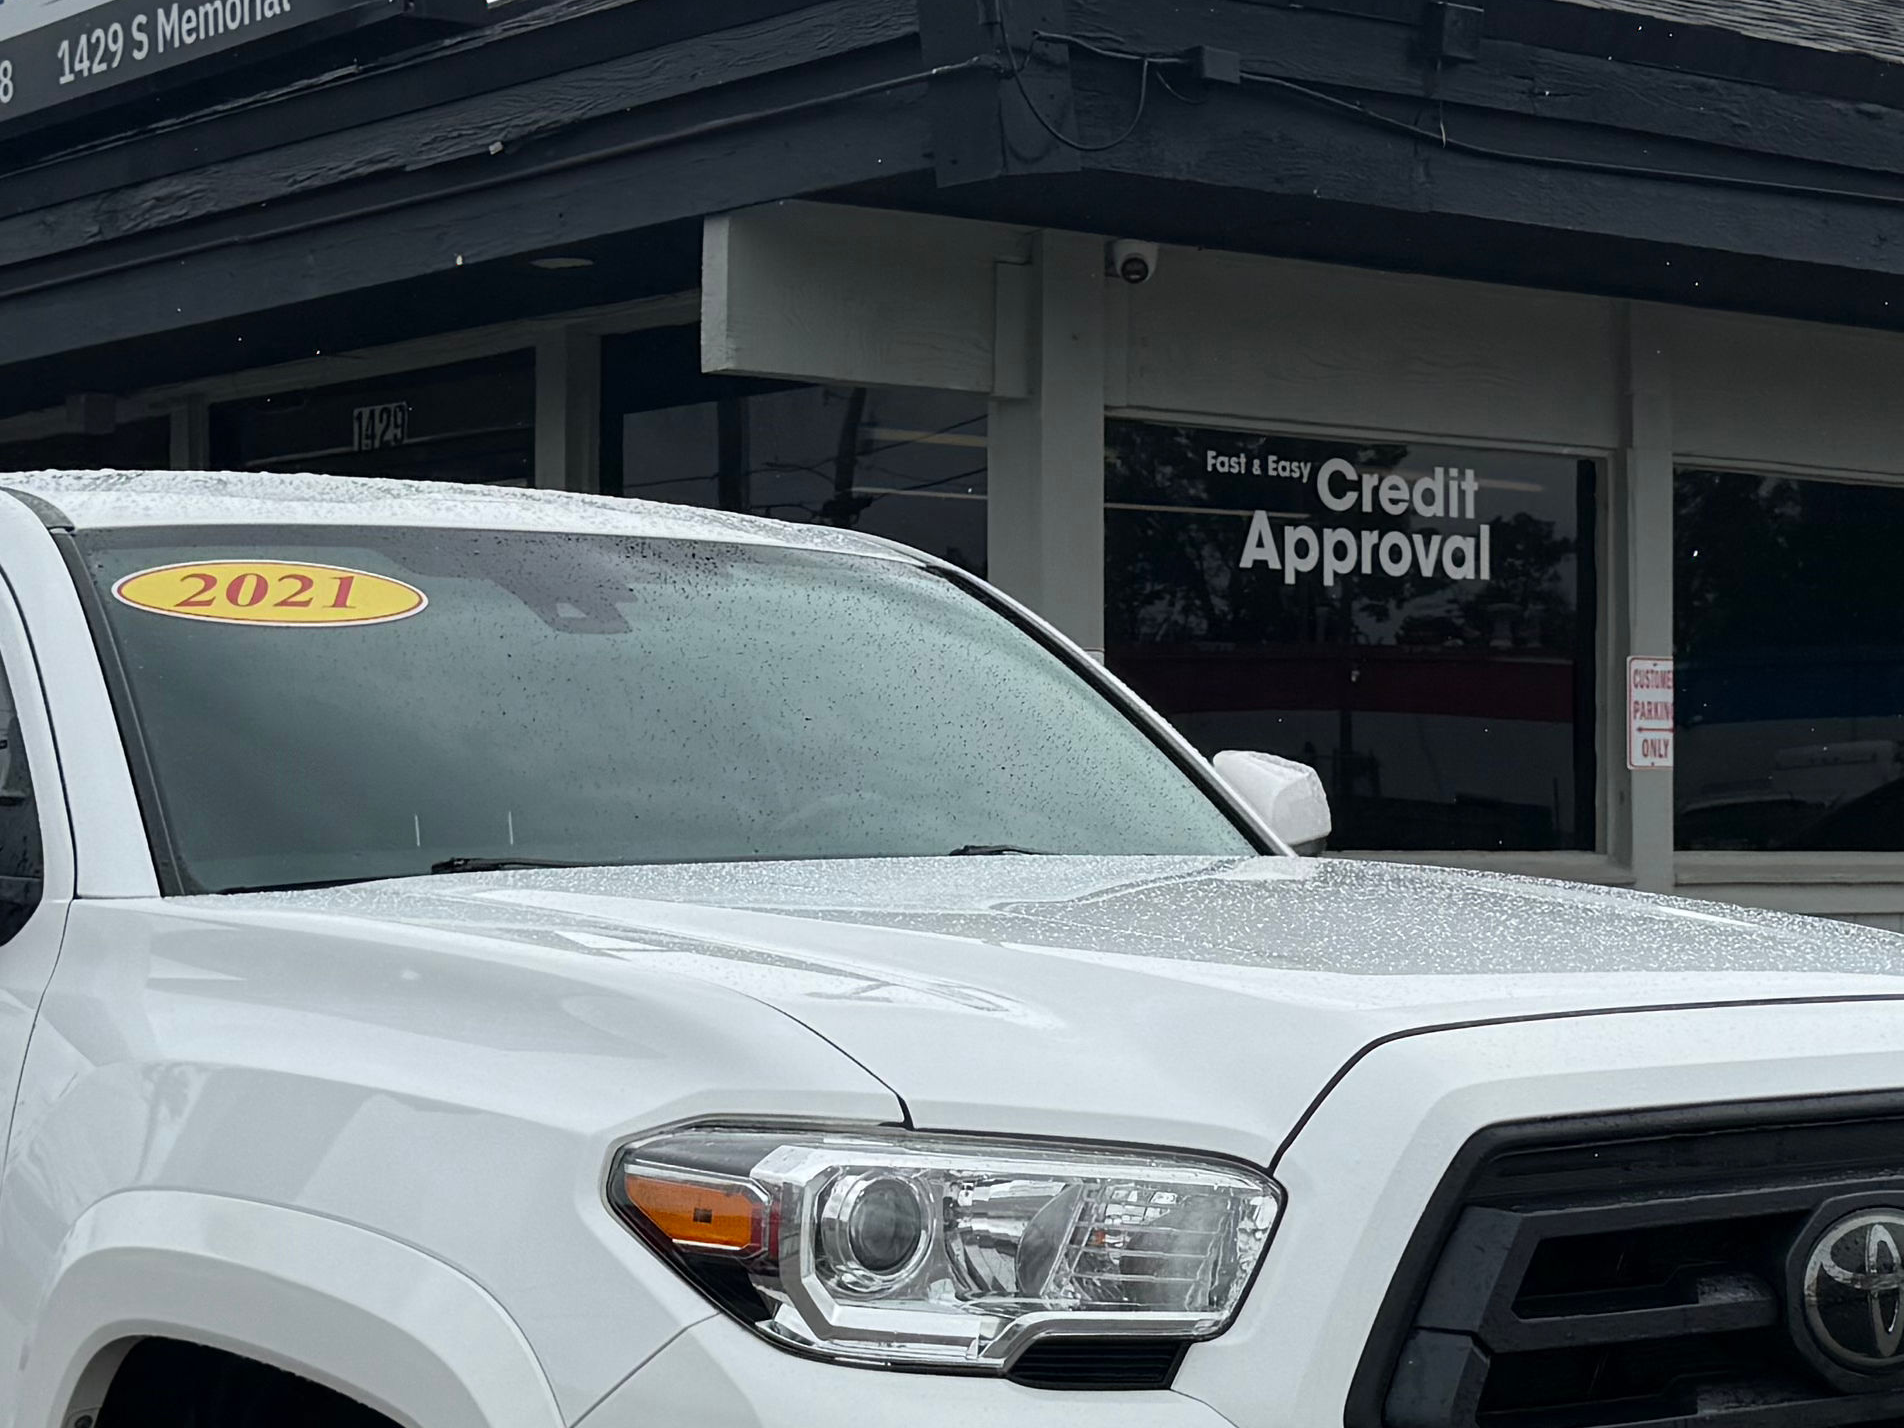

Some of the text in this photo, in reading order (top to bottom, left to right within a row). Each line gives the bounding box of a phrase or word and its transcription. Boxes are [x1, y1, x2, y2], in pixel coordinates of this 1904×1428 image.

[57, 22, 124, 85] 1429
[131, 14, 149, 61] S
[354, 403, 407, 451] 1429
[1206, 450, 1479, 519] Fast & Easy Credit
[1239, 509, 1490, 586] Approval
[174, 572, 357, 609] 2021
[1642, 738, 1670, 758] ONLY
